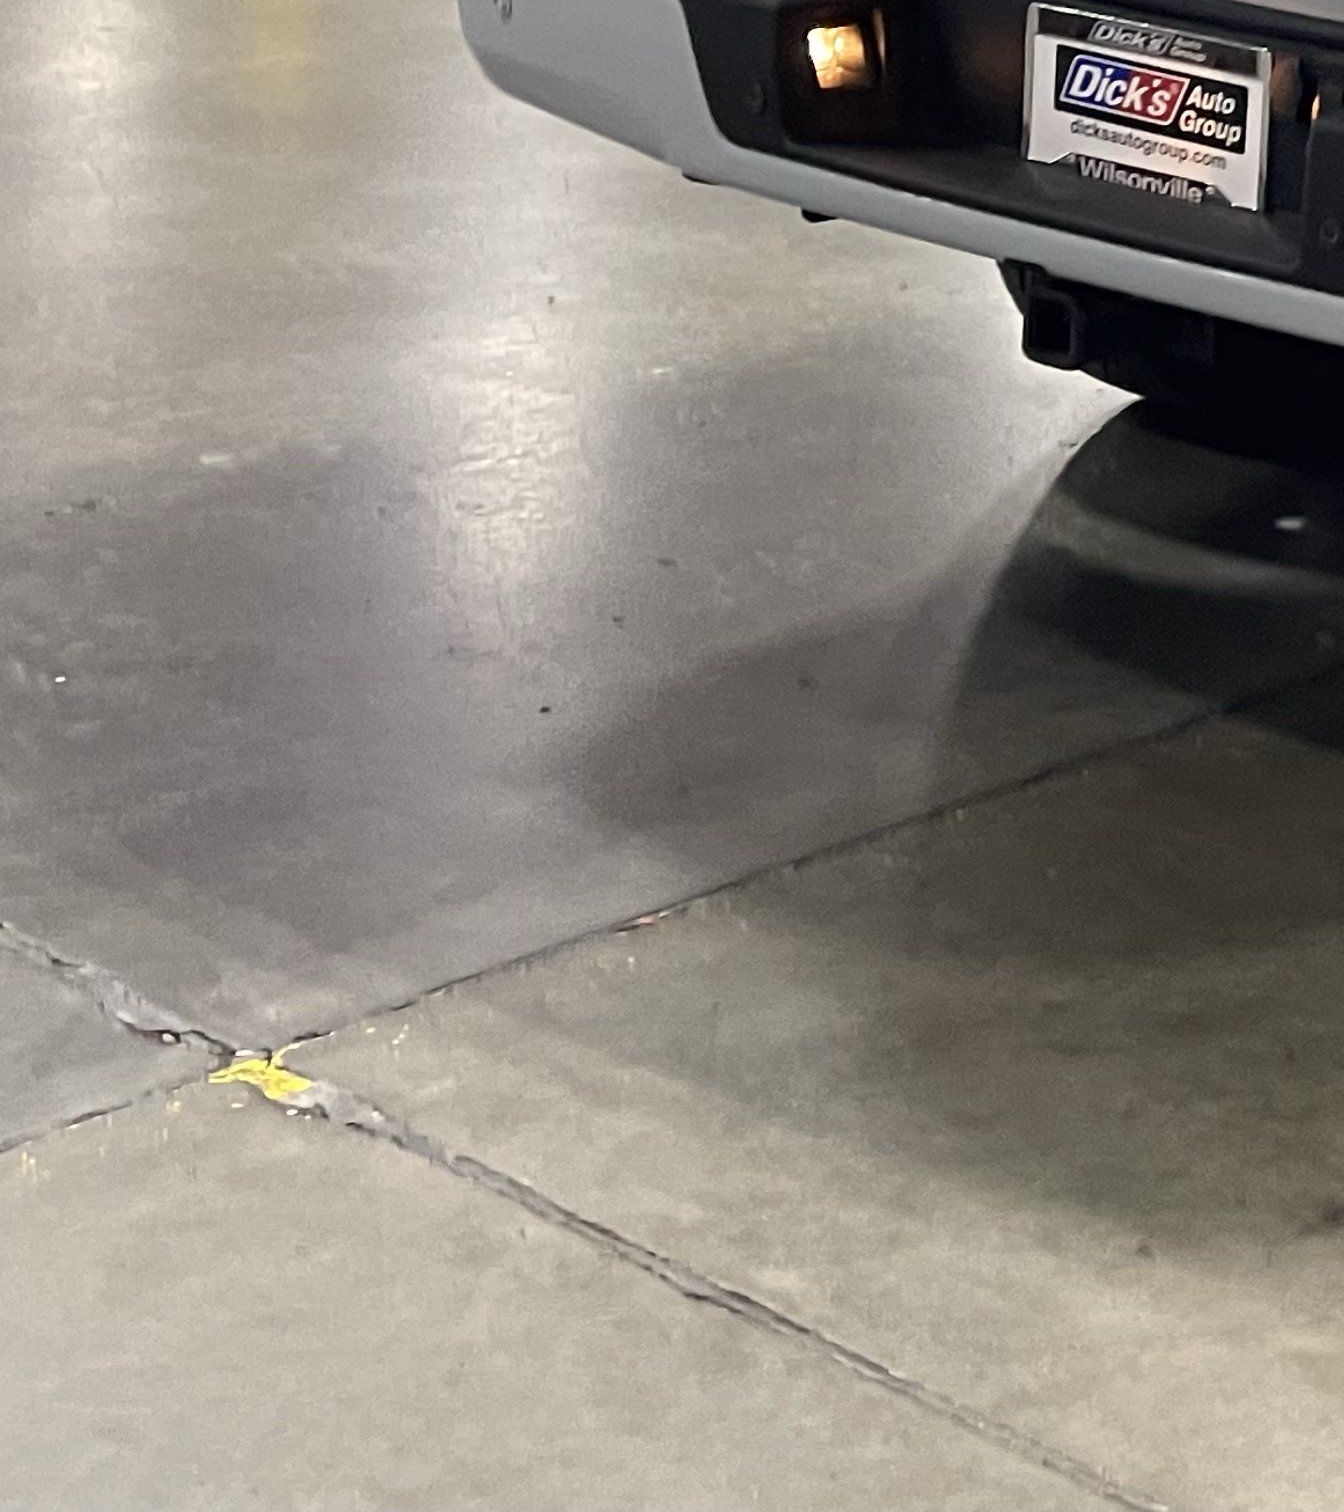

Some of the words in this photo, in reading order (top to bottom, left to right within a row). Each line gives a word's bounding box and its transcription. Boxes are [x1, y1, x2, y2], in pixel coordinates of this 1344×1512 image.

[1068, 63, 1172, 118] Dick's
[1185, 85, 1236, 115] Auto
[1070, 117, 1228, 170] dicksautogroup.com
[1178, 110, 1242, 147] Group
[1077, 157, 1204, 204] Wilsonville
